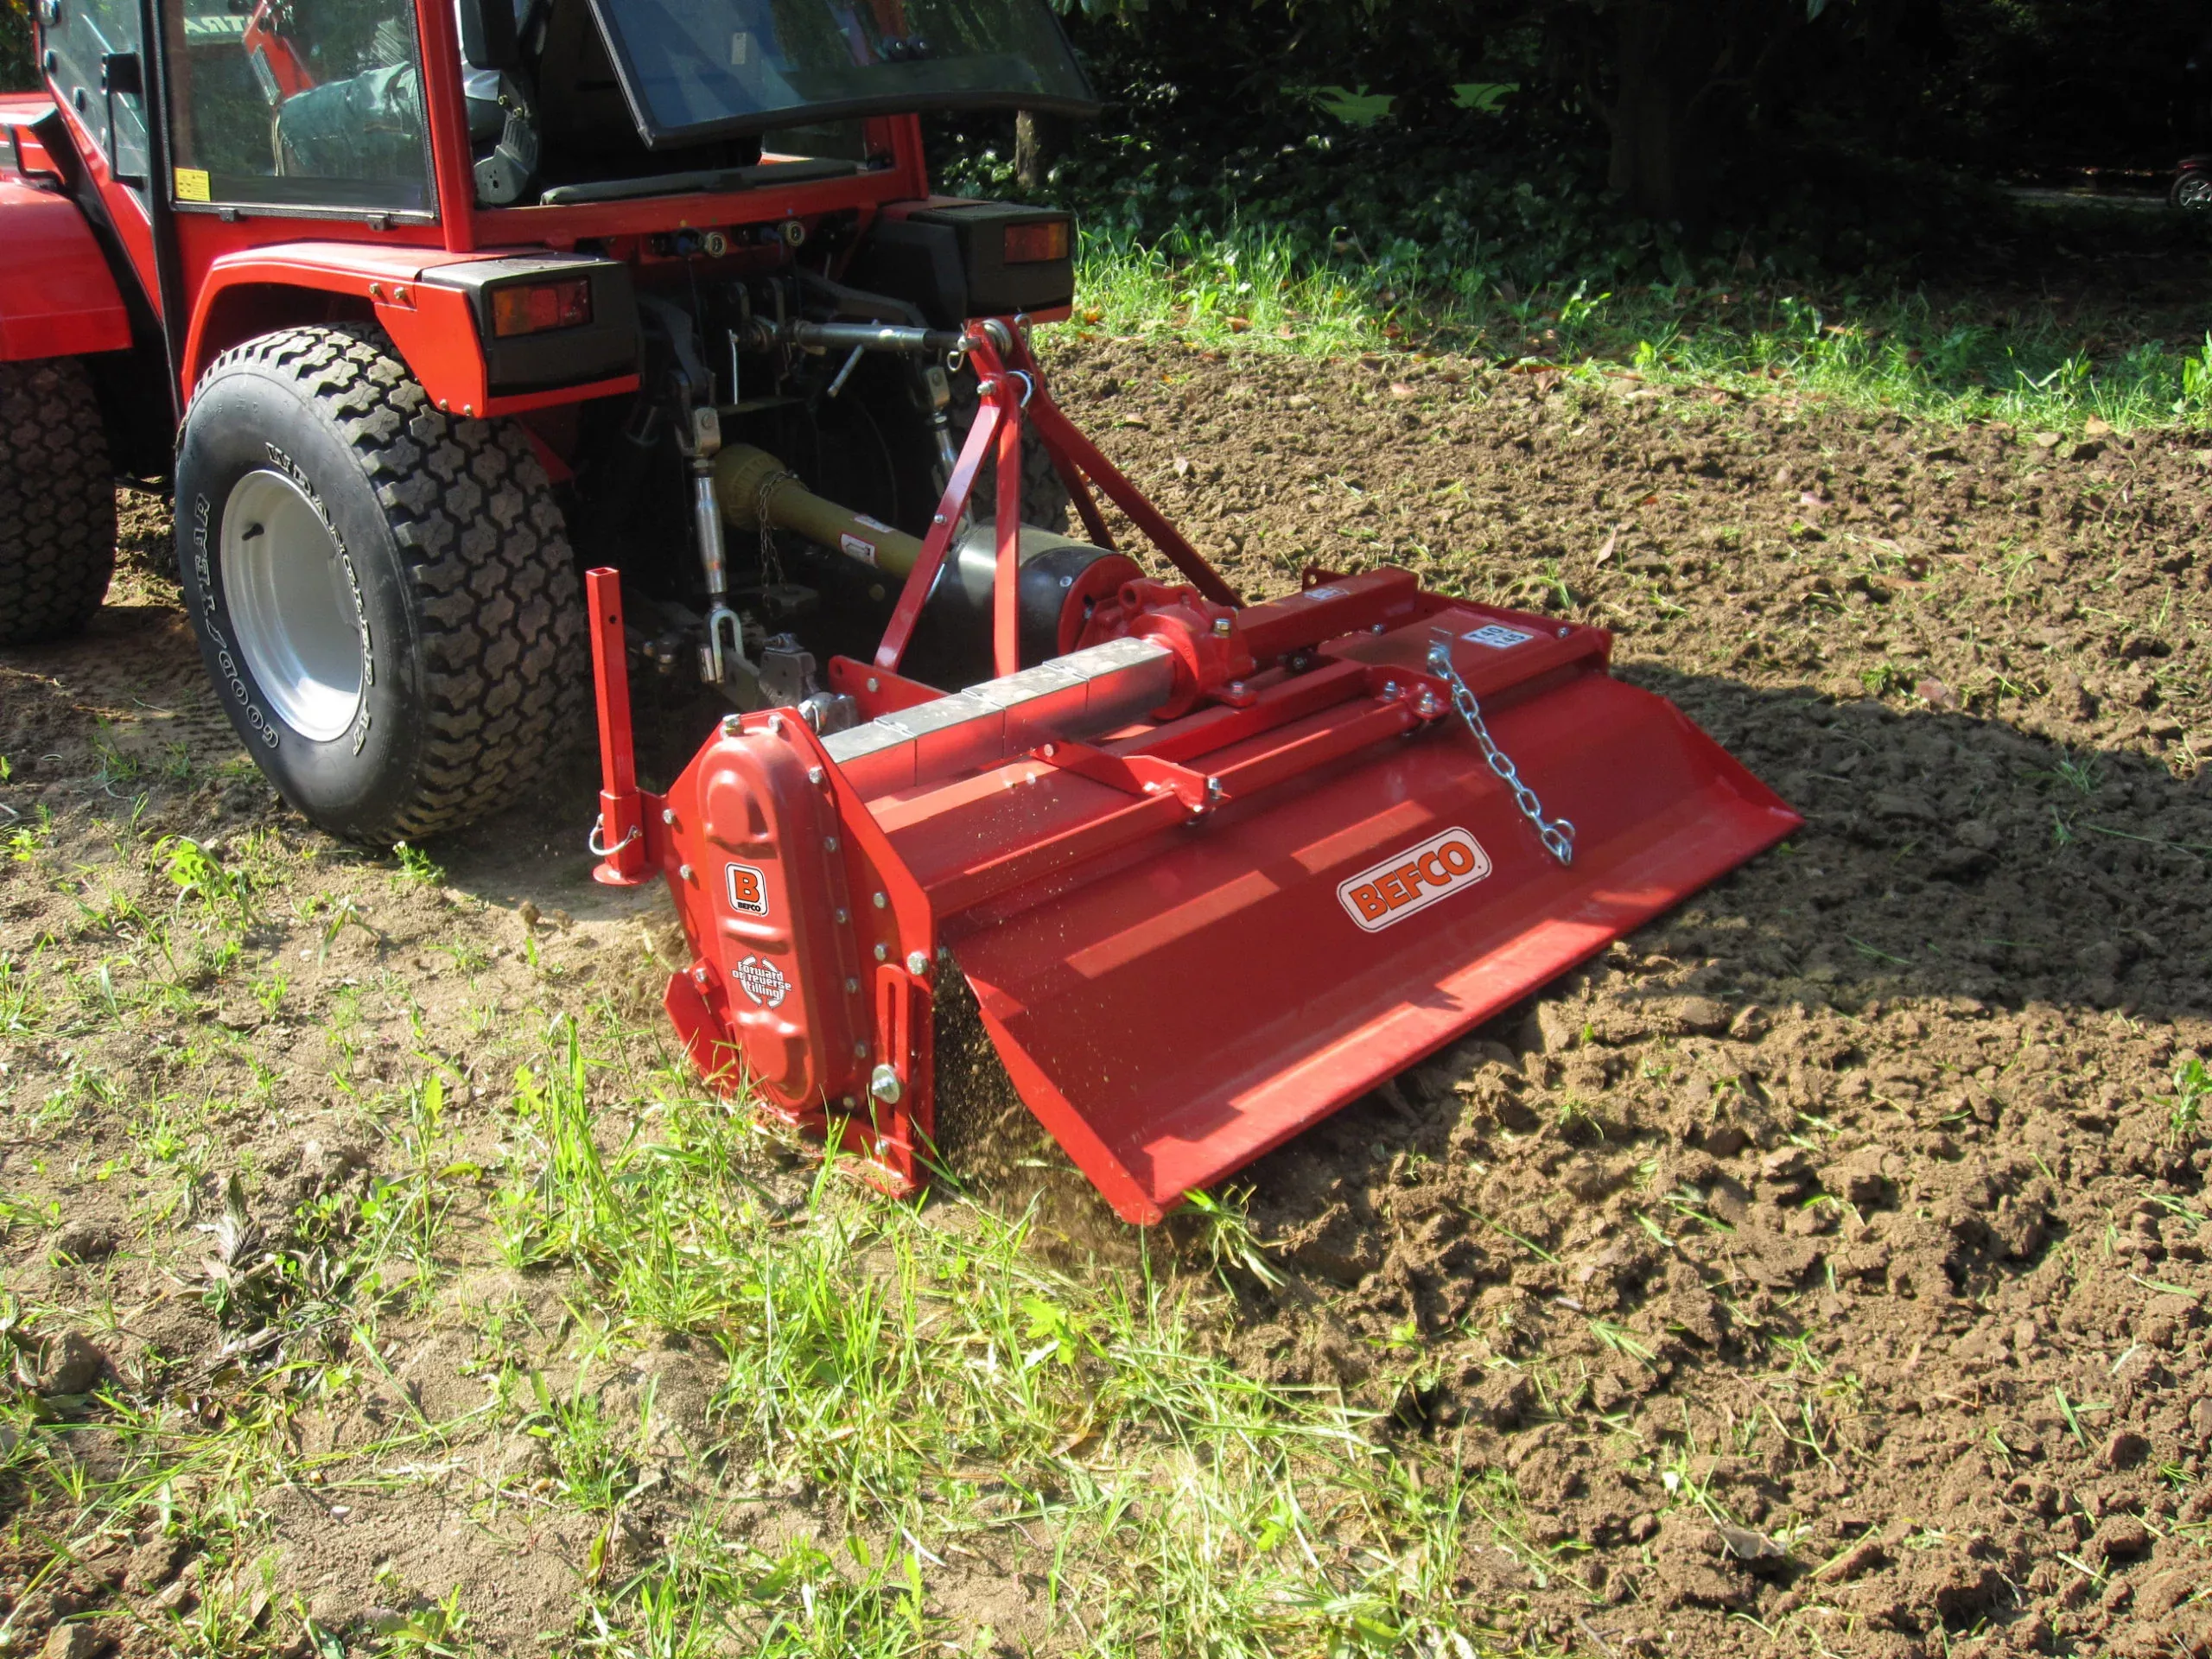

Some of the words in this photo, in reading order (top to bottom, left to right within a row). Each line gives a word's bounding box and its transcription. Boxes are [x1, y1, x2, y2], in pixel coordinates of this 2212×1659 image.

[193, 493, 280, 748] GOODYEAR
[734, 869, 760, 903] B
[1348, 841, 1476, 922] BEFCO
[737, 901, 761, 912] BEFCO
[746, 972, 792, 992] reverse
[746, 980, 781, 1001] tilling
